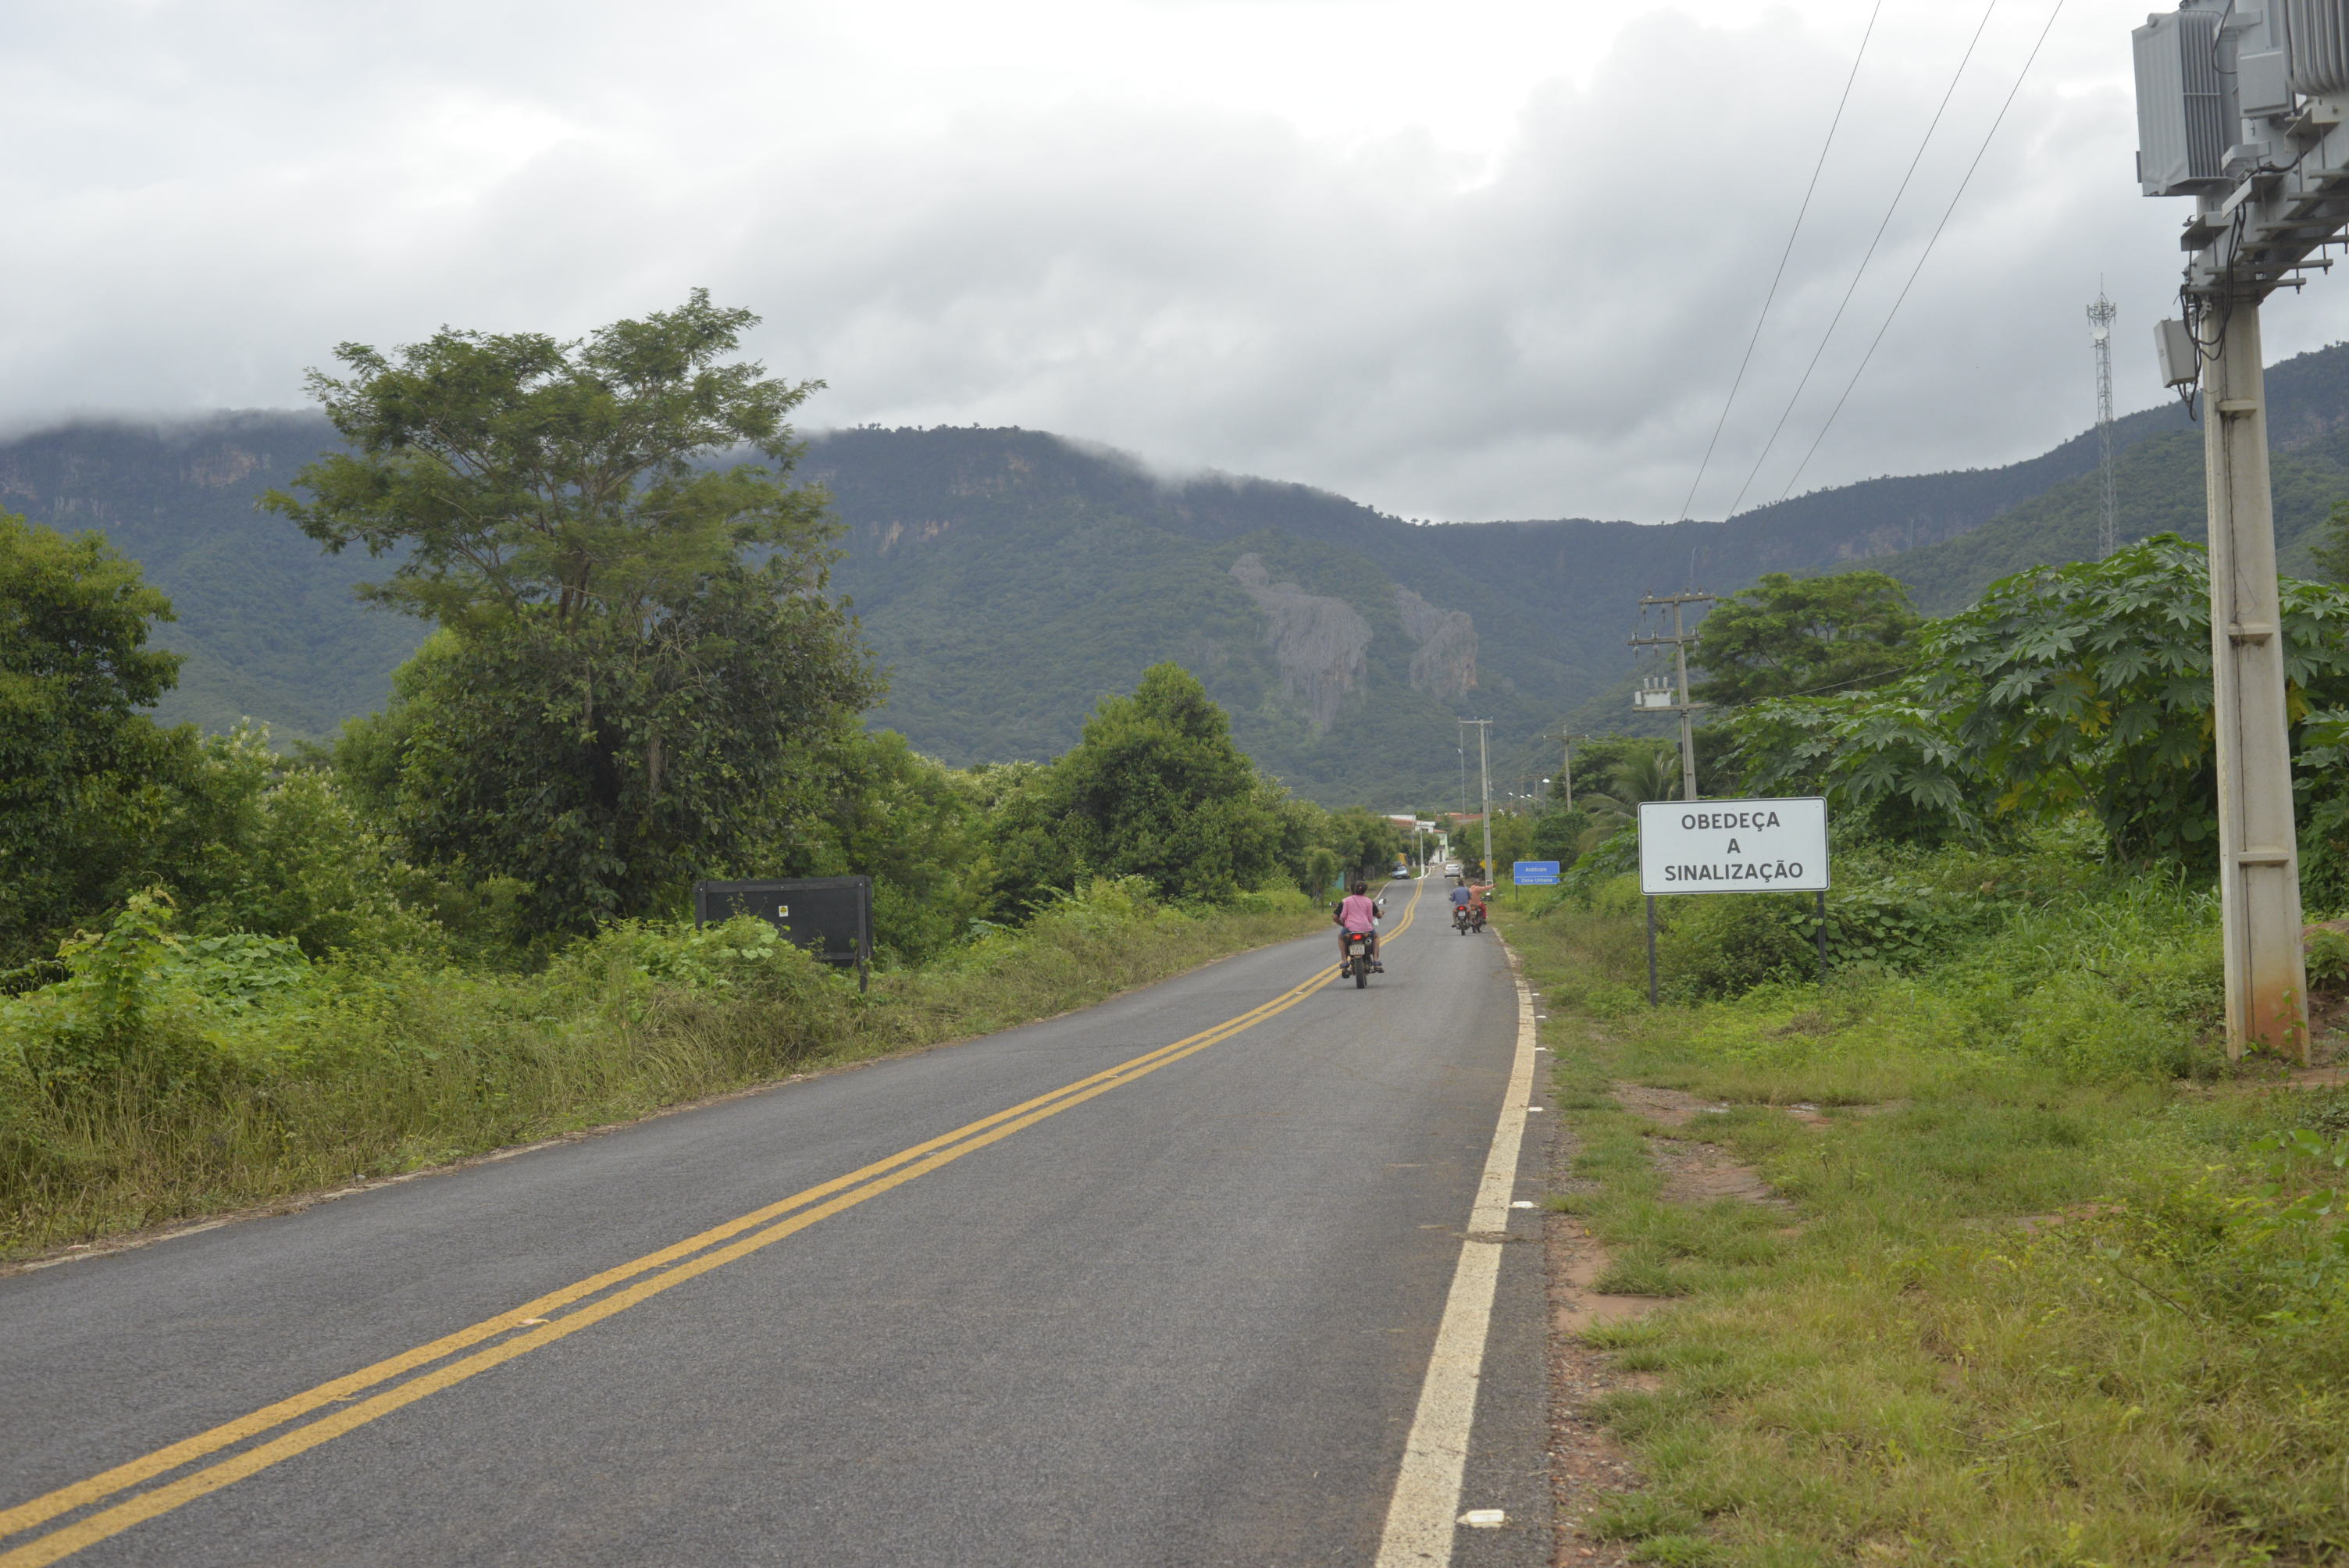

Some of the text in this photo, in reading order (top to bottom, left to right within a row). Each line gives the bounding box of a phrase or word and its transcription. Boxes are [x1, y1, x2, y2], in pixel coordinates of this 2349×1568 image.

[1681, 811, 1780, 832] OBEDEÇA
[1727, 838, 1741, 854] A
[1664, 860, 1803, 883] SINALIZAÇÃO
